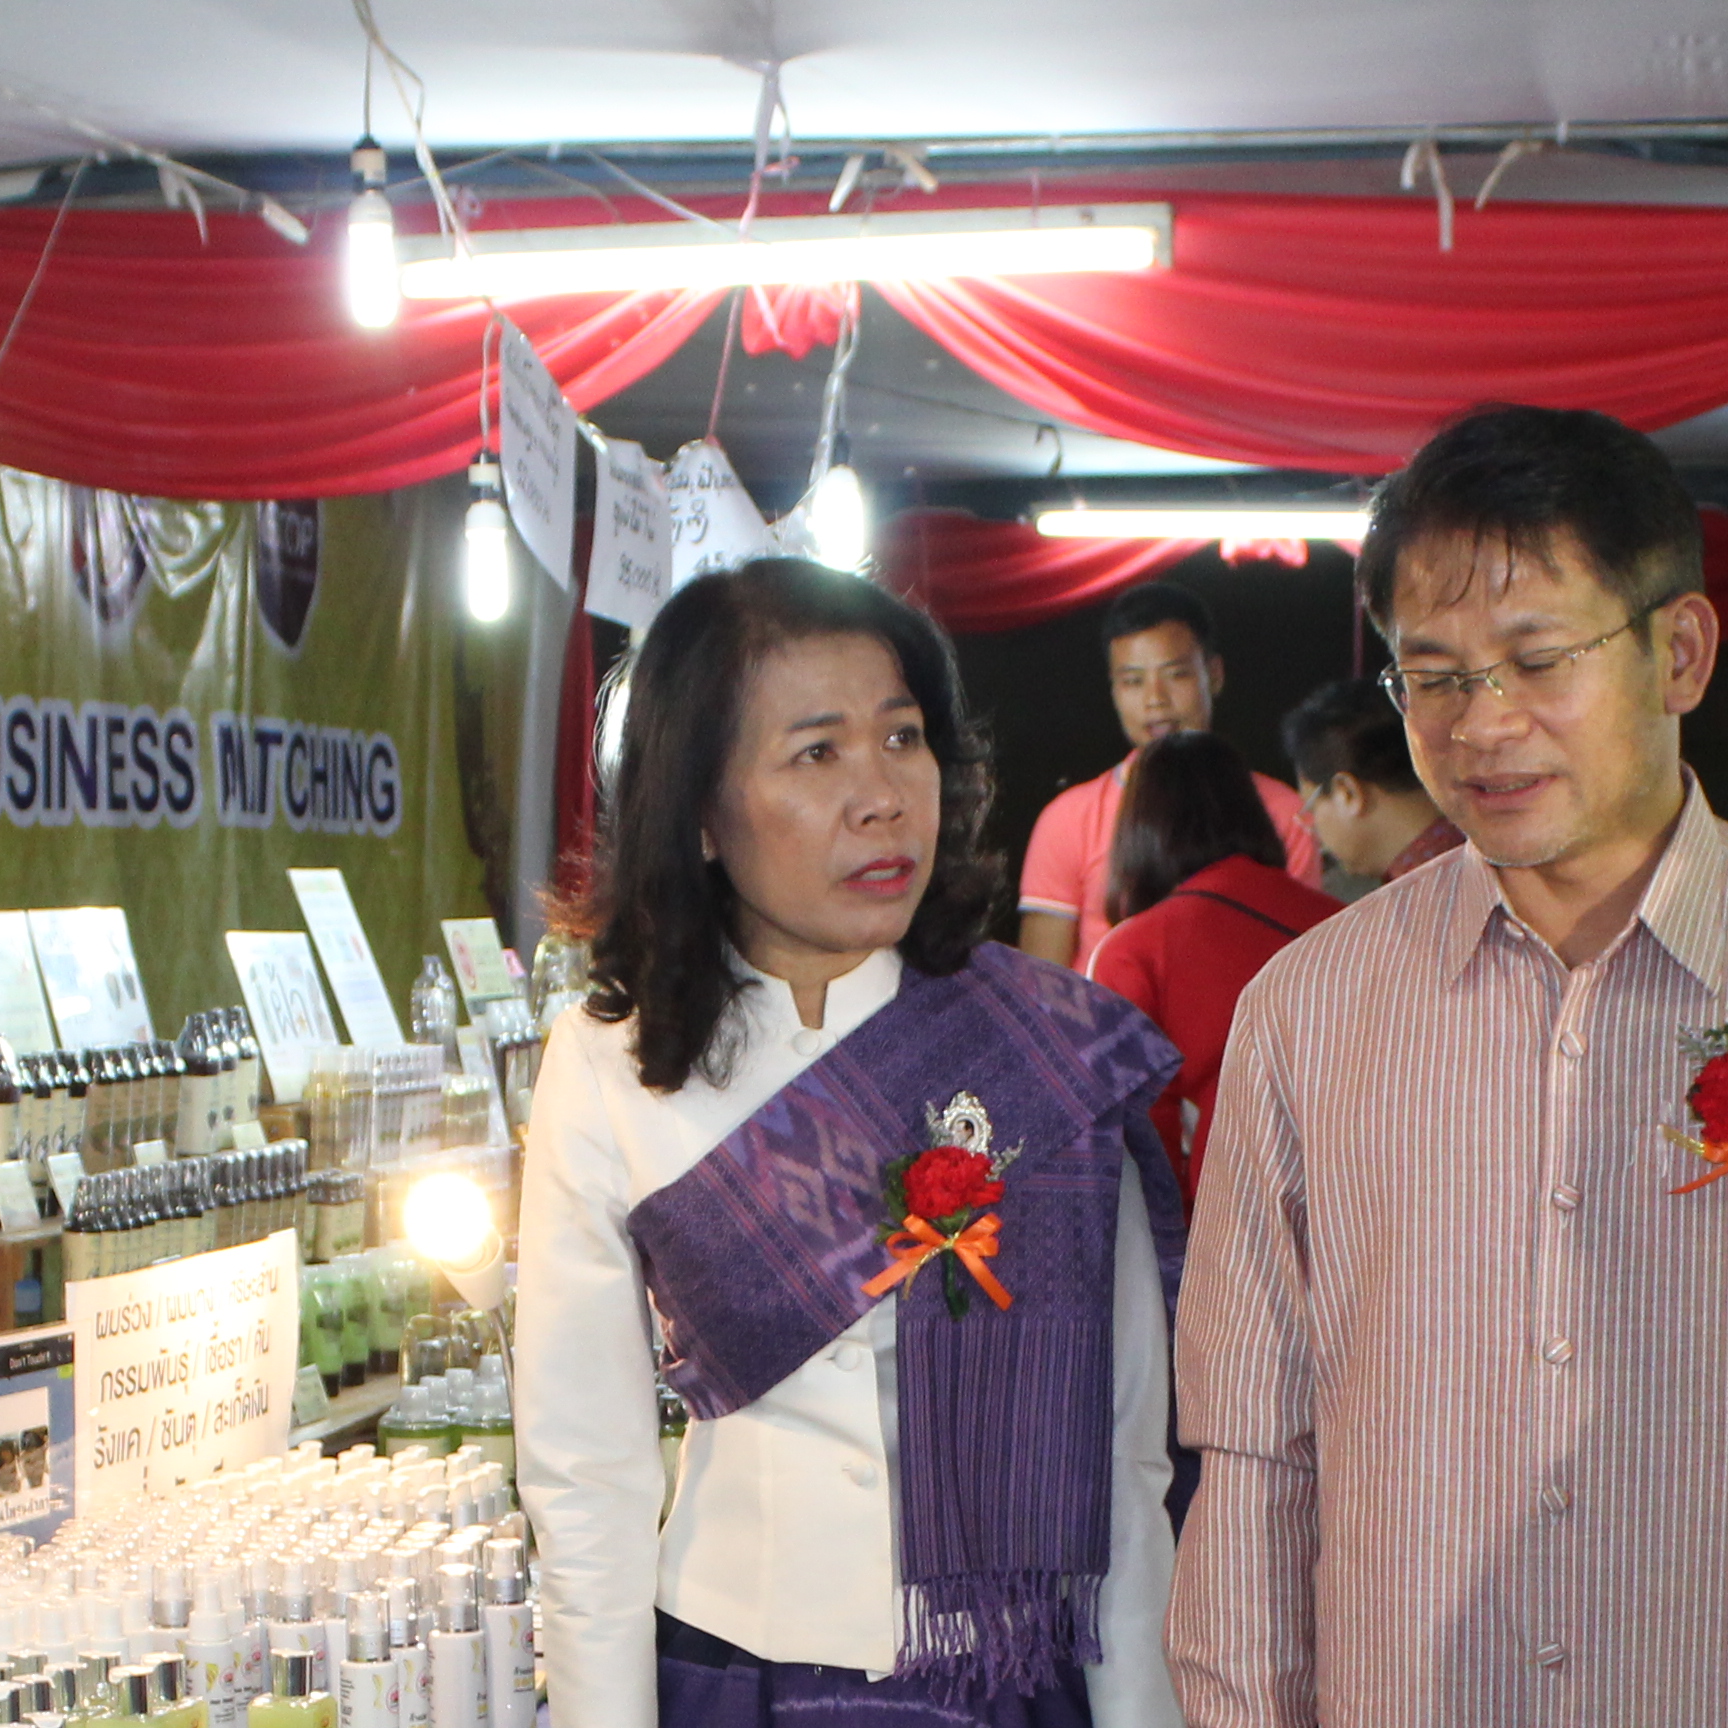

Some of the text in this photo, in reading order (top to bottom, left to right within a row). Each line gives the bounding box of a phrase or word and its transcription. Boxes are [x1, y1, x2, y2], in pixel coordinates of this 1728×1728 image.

[219, 723, 397, 826] MTCHING
[95, 1291, 152, 1340] ผมร่วง
[100, 1338, 191, 1403] กรรมพันธุ์
